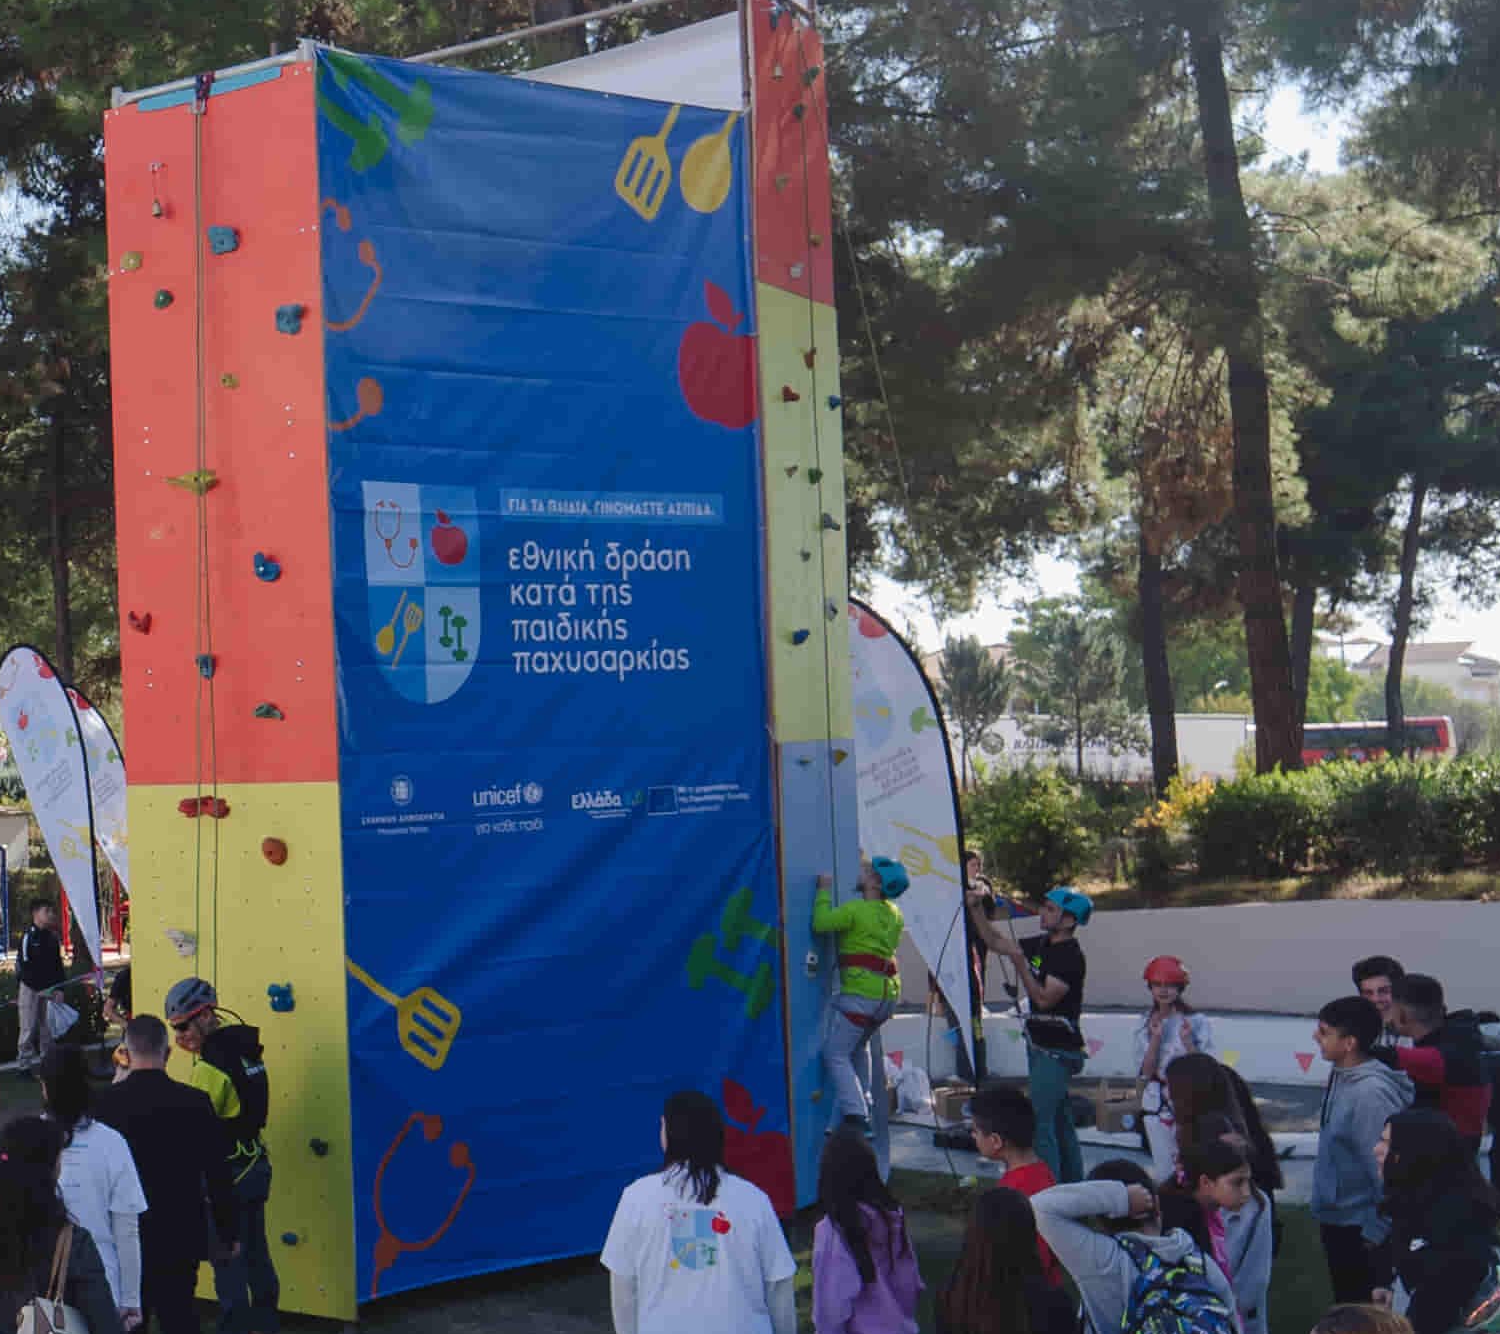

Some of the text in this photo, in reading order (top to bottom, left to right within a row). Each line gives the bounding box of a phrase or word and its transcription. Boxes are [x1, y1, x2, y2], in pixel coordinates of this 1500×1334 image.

[507, 538, 692, 581] εθνική δράση
[509, 572, 633, 606] κατά της
[511, 607, 629, 642] παιδικής
[511, 638, 690, 682] παχυσαρκίας
[472, 783, 522, 807] unicef
